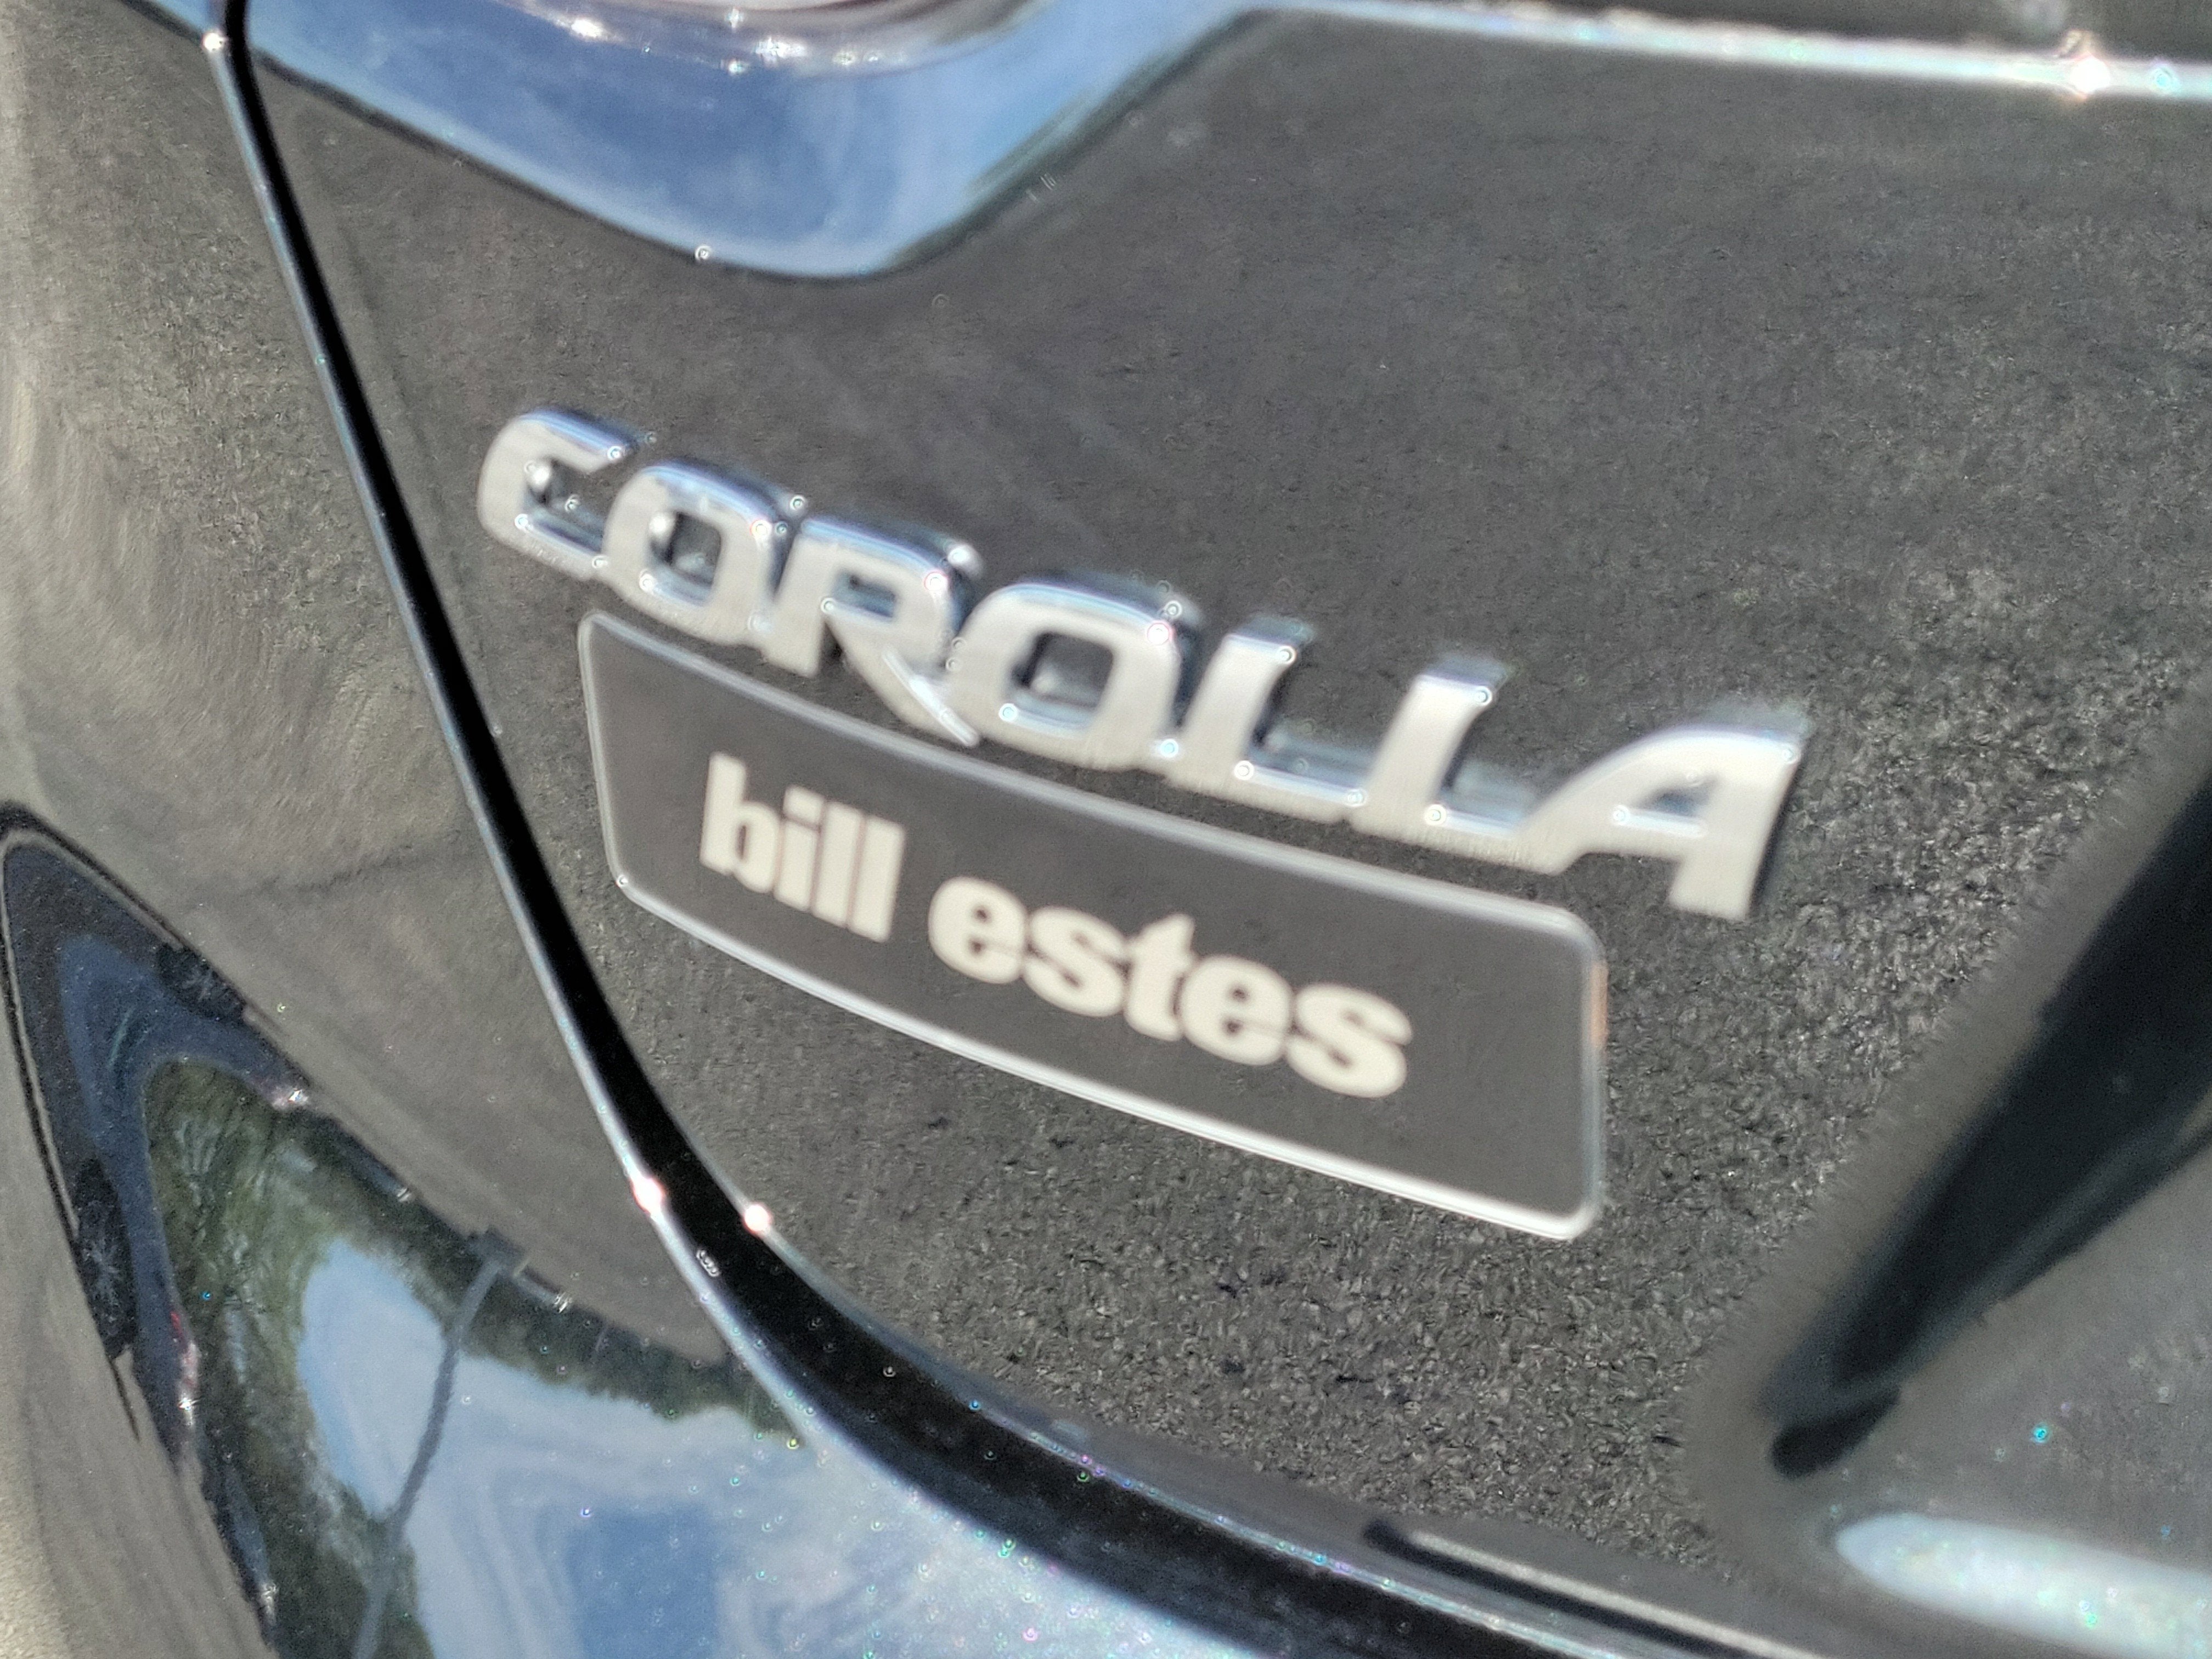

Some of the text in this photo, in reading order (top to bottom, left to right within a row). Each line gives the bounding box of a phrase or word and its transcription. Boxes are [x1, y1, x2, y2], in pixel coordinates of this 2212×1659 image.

[476, 408, 1809, 920] COROLLA
[699, 751, 1412, 1098] bill estes
